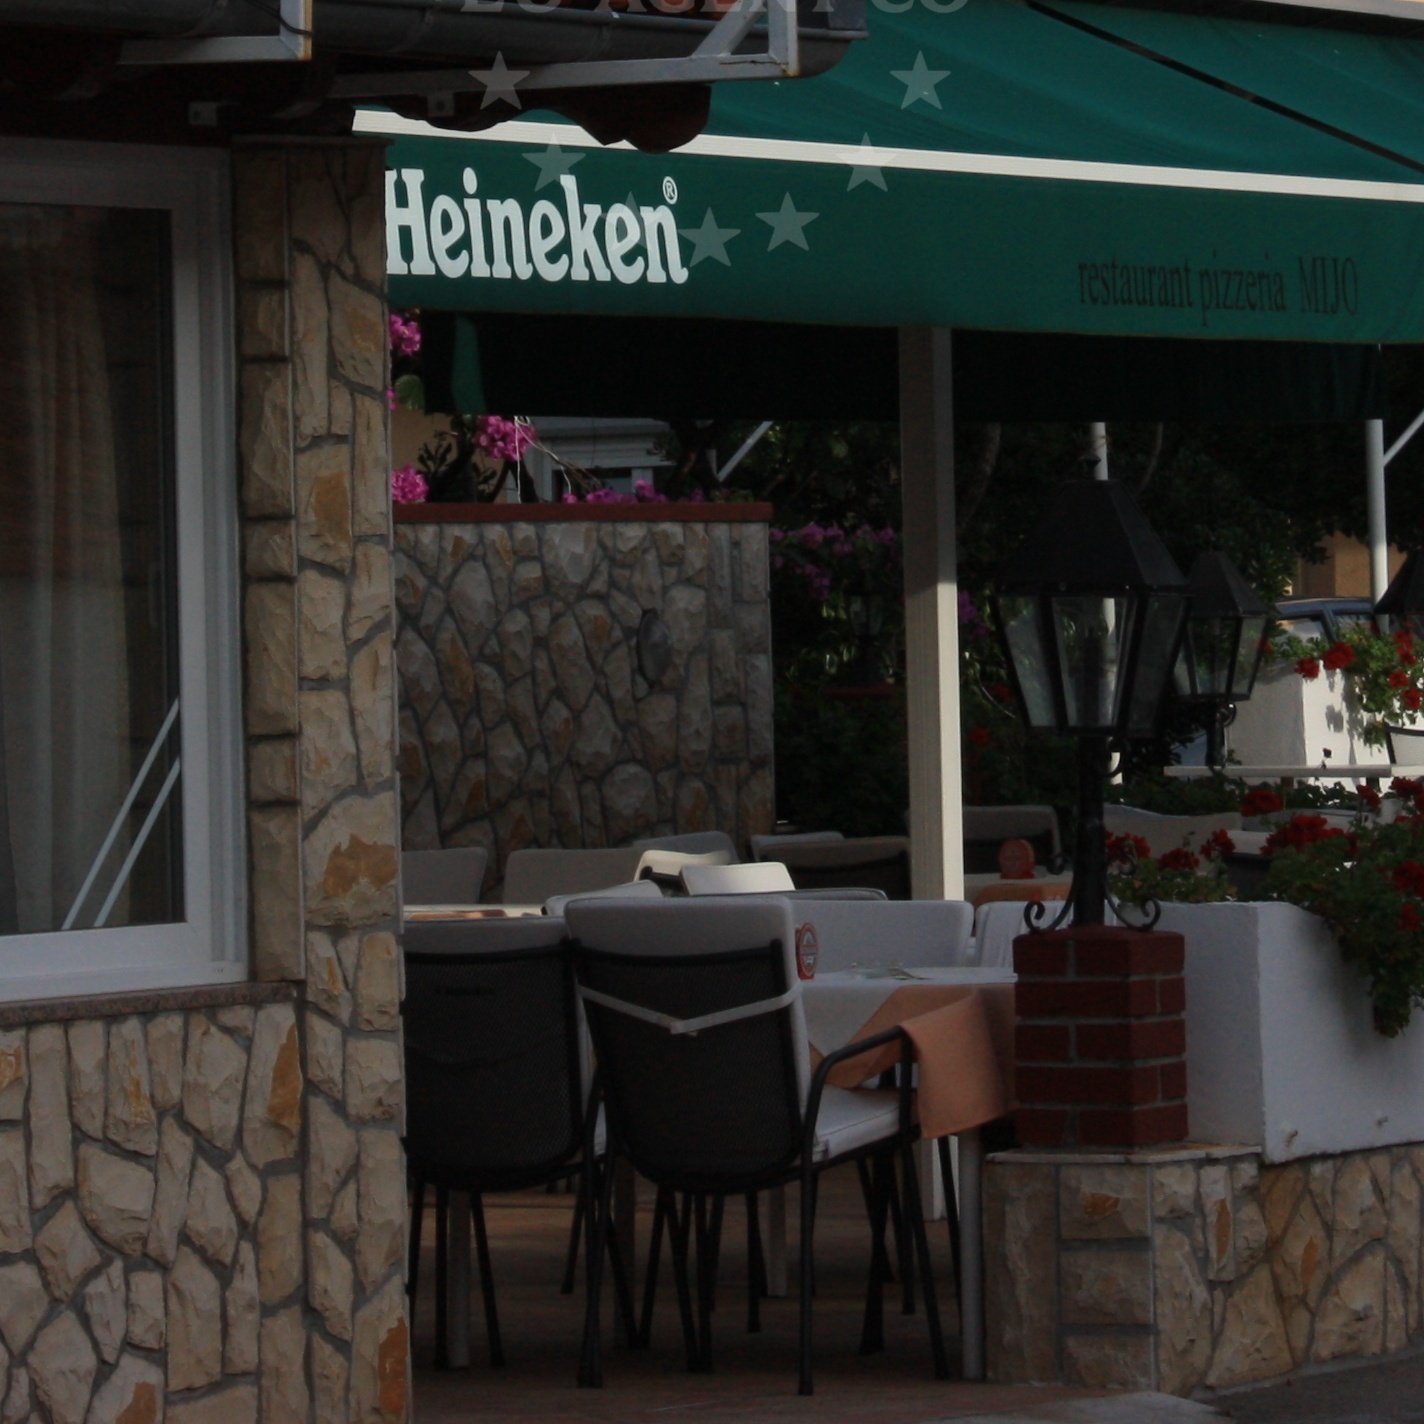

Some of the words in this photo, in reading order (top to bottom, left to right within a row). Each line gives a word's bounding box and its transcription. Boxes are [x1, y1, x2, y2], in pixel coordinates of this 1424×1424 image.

[1078, 257, 1194, 309] restaurant
[1200, 251, 1287, 326] pizzeria
[1299, 257, 1359, 316] MIJO
